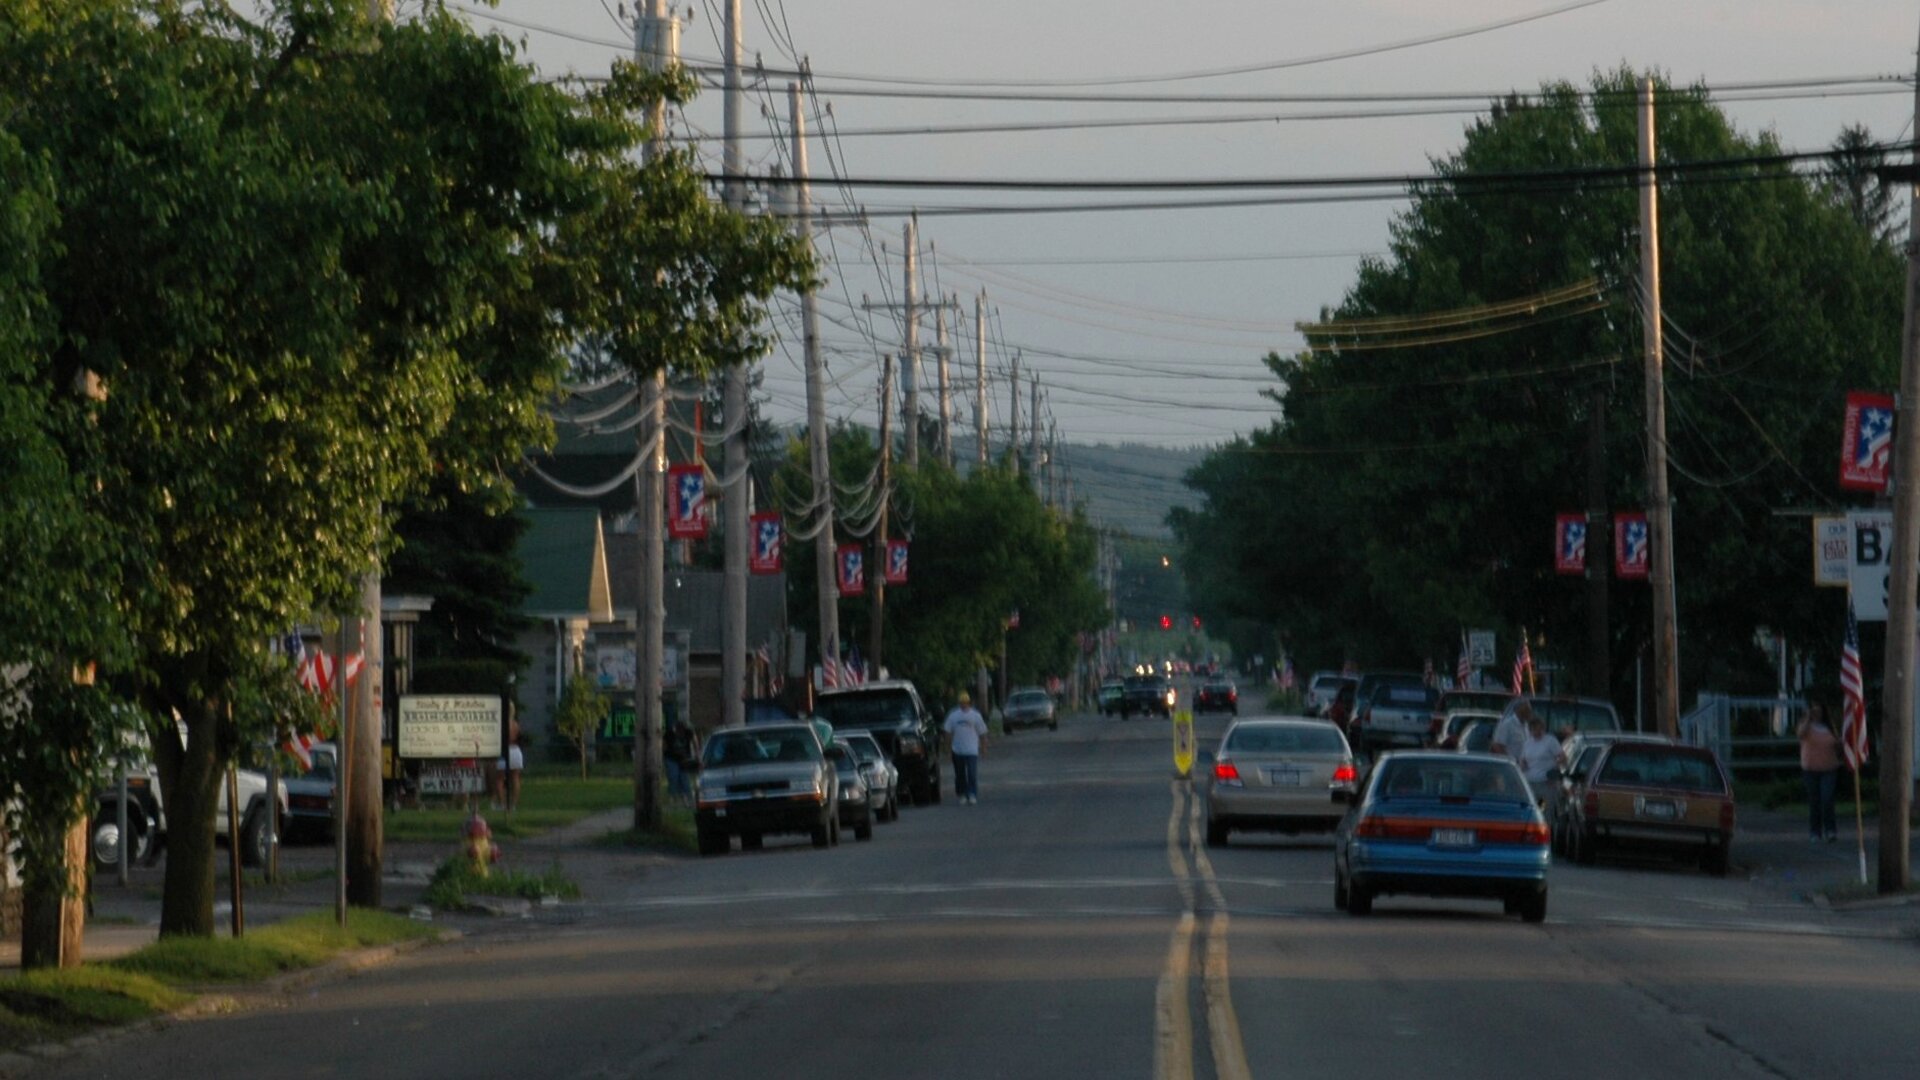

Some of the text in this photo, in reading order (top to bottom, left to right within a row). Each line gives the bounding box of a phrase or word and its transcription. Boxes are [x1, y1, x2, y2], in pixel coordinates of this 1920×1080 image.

[1472, 649, 1493, 662] 25
[408, 711, 494, 722] LOCKSMITH
[439, 779, 463, 792] KEYS
